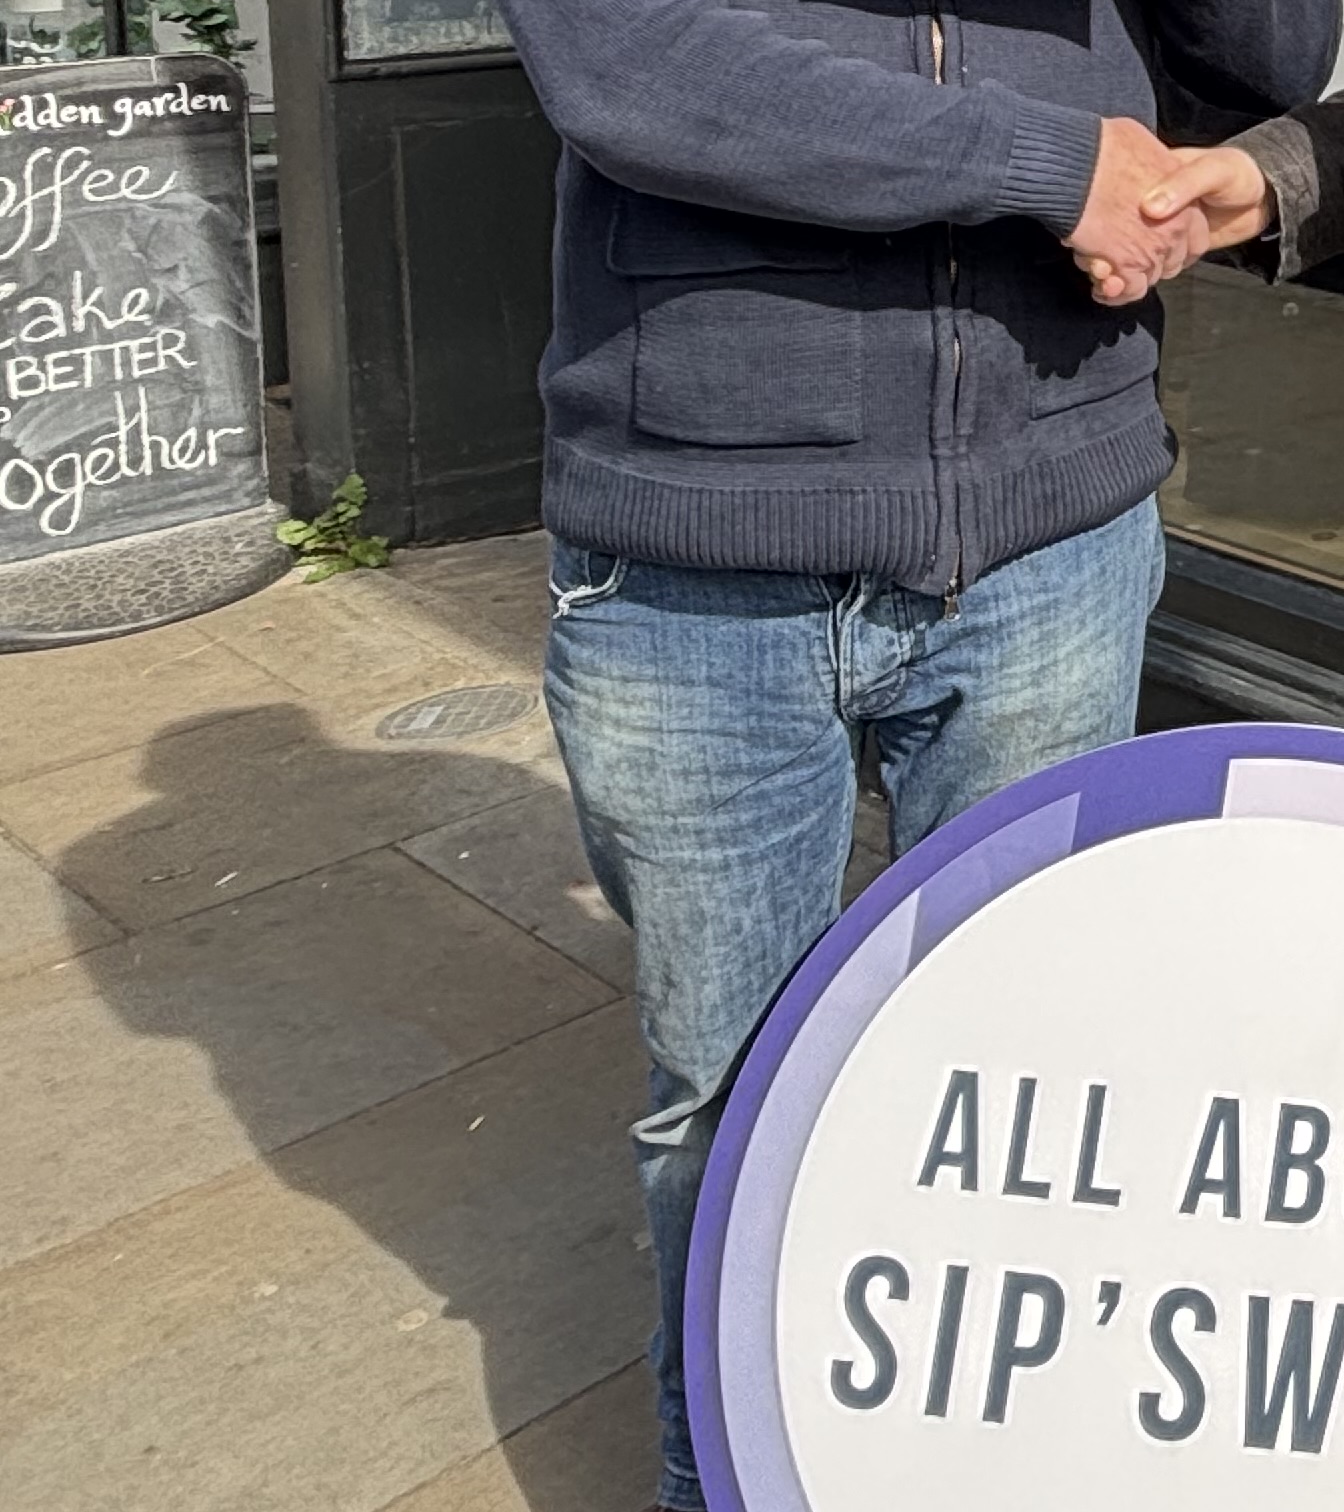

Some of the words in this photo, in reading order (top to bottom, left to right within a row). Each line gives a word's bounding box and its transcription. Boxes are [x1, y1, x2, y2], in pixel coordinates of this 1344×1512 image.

[0, 92, 107, 136] idden
[106, 82, 232, 137] garden
[0, 146, 180, 259] offee
[6, 328, 199, 400] BETTER
[0, 383, 246, 537] ogether
[916, 1069, 1123, 1208] ALL
